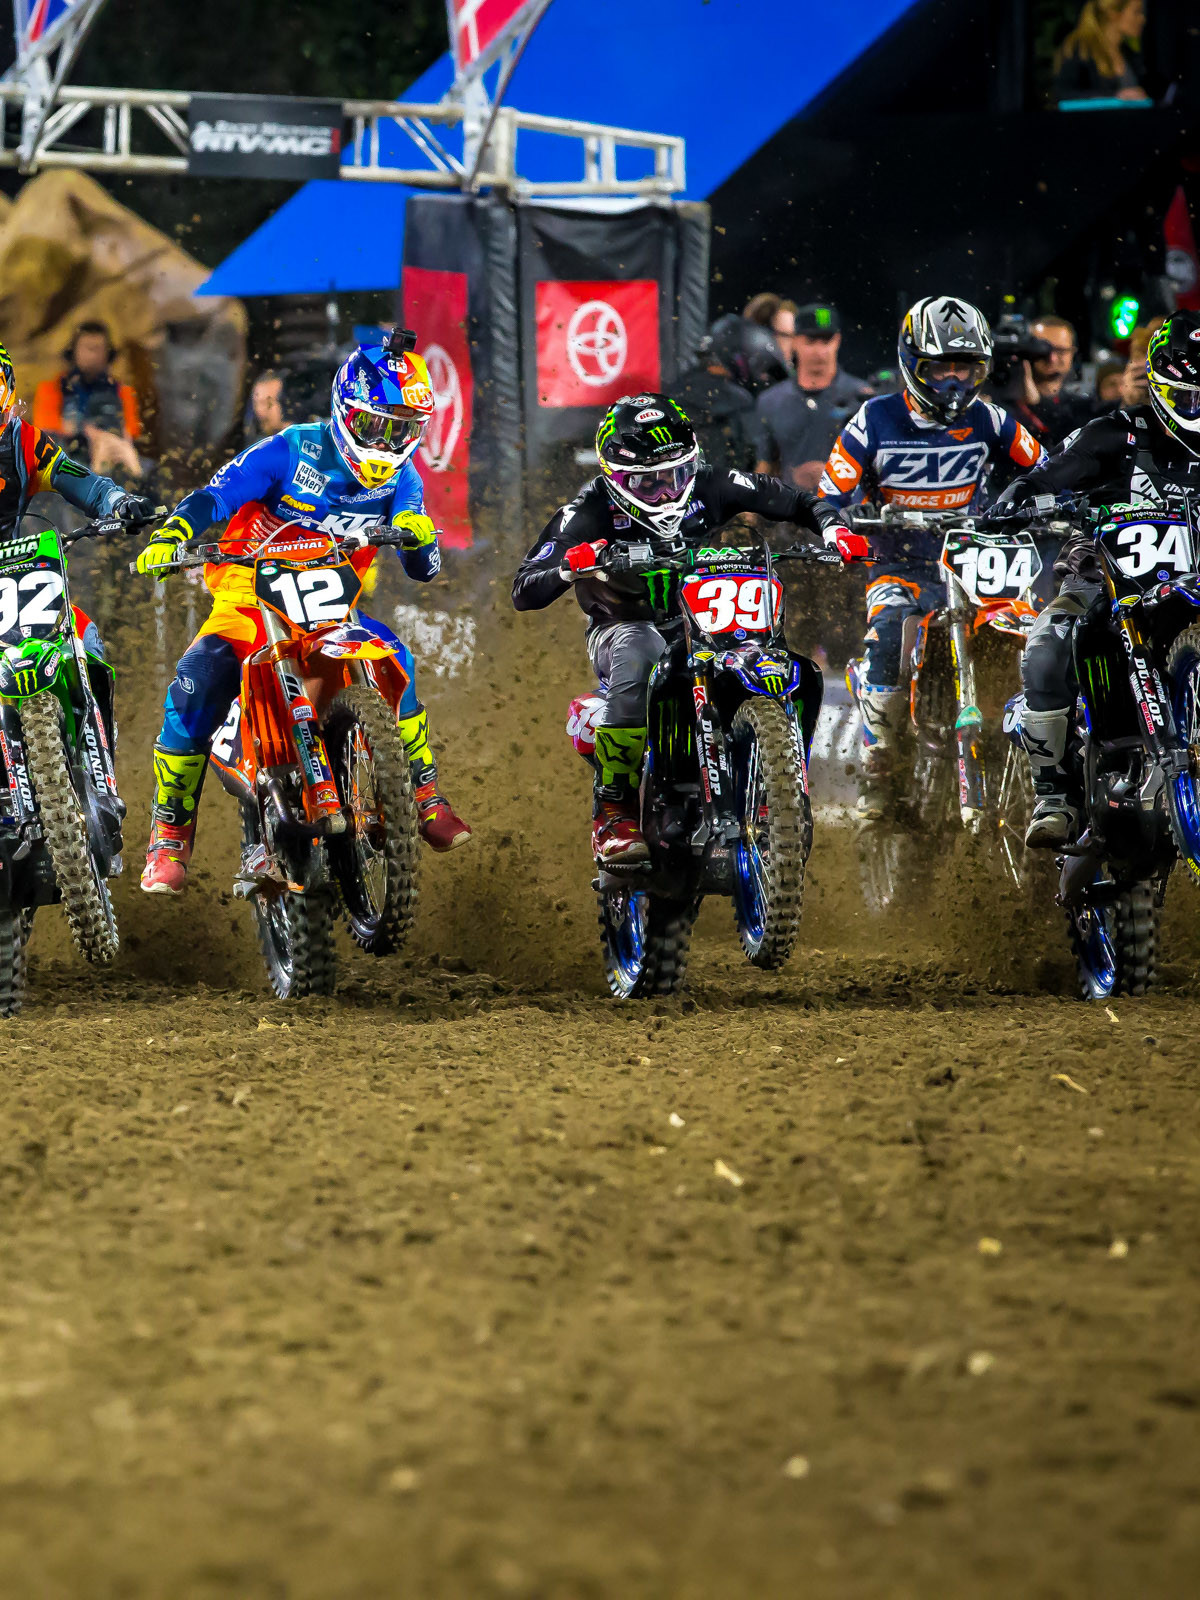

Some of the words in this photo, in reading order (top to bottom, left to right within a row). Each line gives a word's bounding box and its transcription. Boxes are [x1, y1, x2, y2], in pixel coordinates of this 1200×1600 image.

[640, 411, 659, 420] BELL
[295, 471, 323, 494] bakery
[880, 448, 985, 484] FXR
[891, 492, 941, 506] RACE
[267, 541, 325, 553] RENTHAL
[1117, 524, 1191, 577] 34
[0, 563, 35, 574] MONSTER
[953, 547, 1033, 600] 194
[269, 569, 350, 624] 12
[694, 579, 778, 633] 39
[1141, 701, 1156, 736] BRAKING
